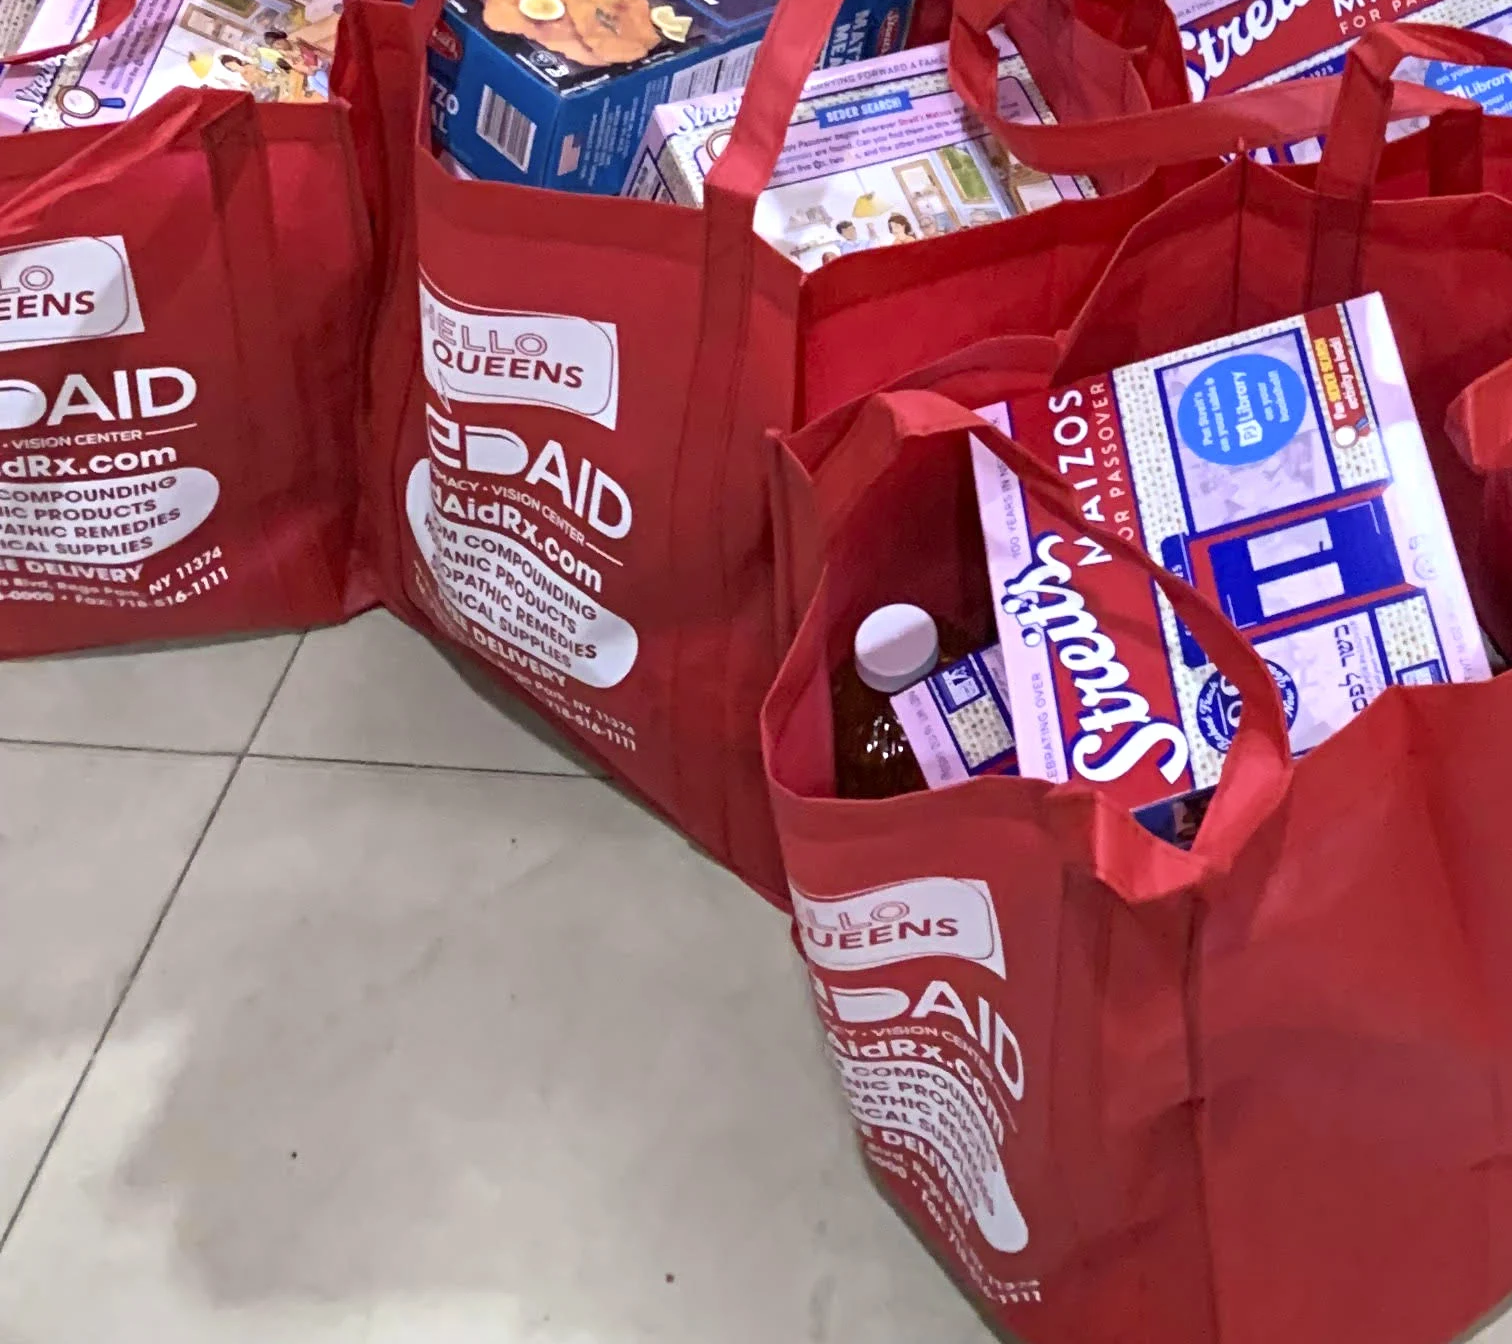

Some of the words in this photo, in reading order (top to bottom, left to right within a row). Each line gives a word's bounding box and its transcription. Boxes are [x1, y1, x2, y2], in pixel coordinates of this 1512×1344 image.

[1340, 8, 1382, 36] FOR
[421, 303, 548, 358] HELLO
[432, 338, 585, 390] QUEENS
[1230, 370, 1255, 424] Library
[1256, 381, 1274, 407] your
[12, 434, 72, 450] VISION
[74, 429, 143, 446] CENTER
[1090, 381, 1127, 499] PASSOVER
[0, 445, 178, 479] dRx.com
[34, 498, 157, 522] PRODUCTS
[74, 507, 181, 540] REMEDIES
[490, 483, 541, 512] VISION
[541, 504, 587, 547] CENTER
[1001, 493, 1017, 532] YEARS
[54, 535, 154, 557] SUPPLIES
[431, 485, 603, 594] dAidRx.com
[1009, 535, 1022, 559] 100
[25, 559, 145, 584] DELIVERY
[148, 573, 172, 596] NY
[175, 545, 224, 581] 11374
[463, 533, 598, 621] COMPOUNDING
[495, 563, 577, 635] PRODUCTS
[499, 615, 573, 670] SUPPLIES
[516, 606, 598, 660] REMEDIES
[472, 626, 569, 688] DELIVERY
[1000, 529, 1190, 786] Streit's
[1030, 671, 1047, 710] OVER
[805, 900, 911, 934] LLO
[806, 916, 959, 951] UEENS
[868, 1024, 939, 1038] VISION
